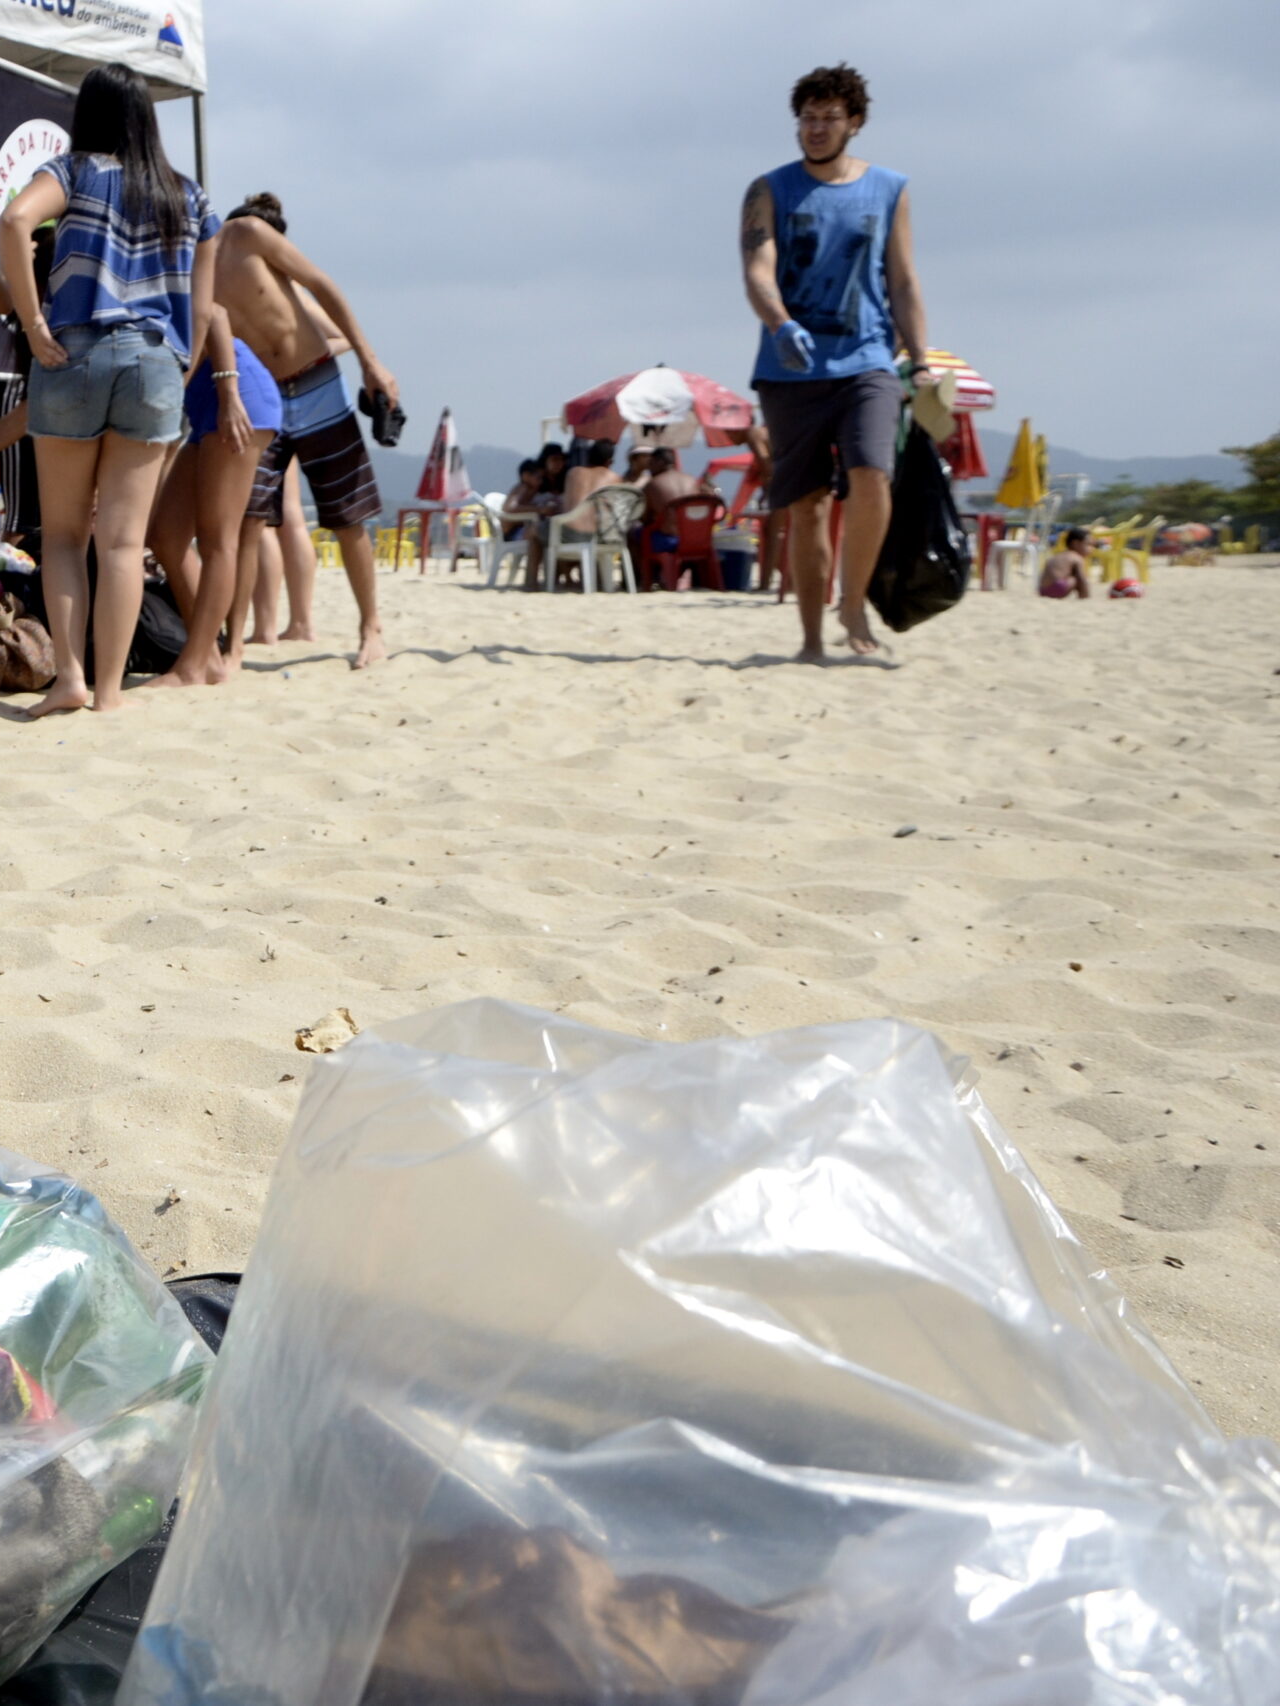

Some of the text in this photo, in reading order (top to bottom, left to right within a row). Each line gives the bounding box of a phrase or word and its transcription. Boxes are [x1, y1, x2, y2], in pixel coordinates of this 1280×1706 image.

[76, 7, 147, 37] do ambiente
[18, 132, 35, 156] DA
